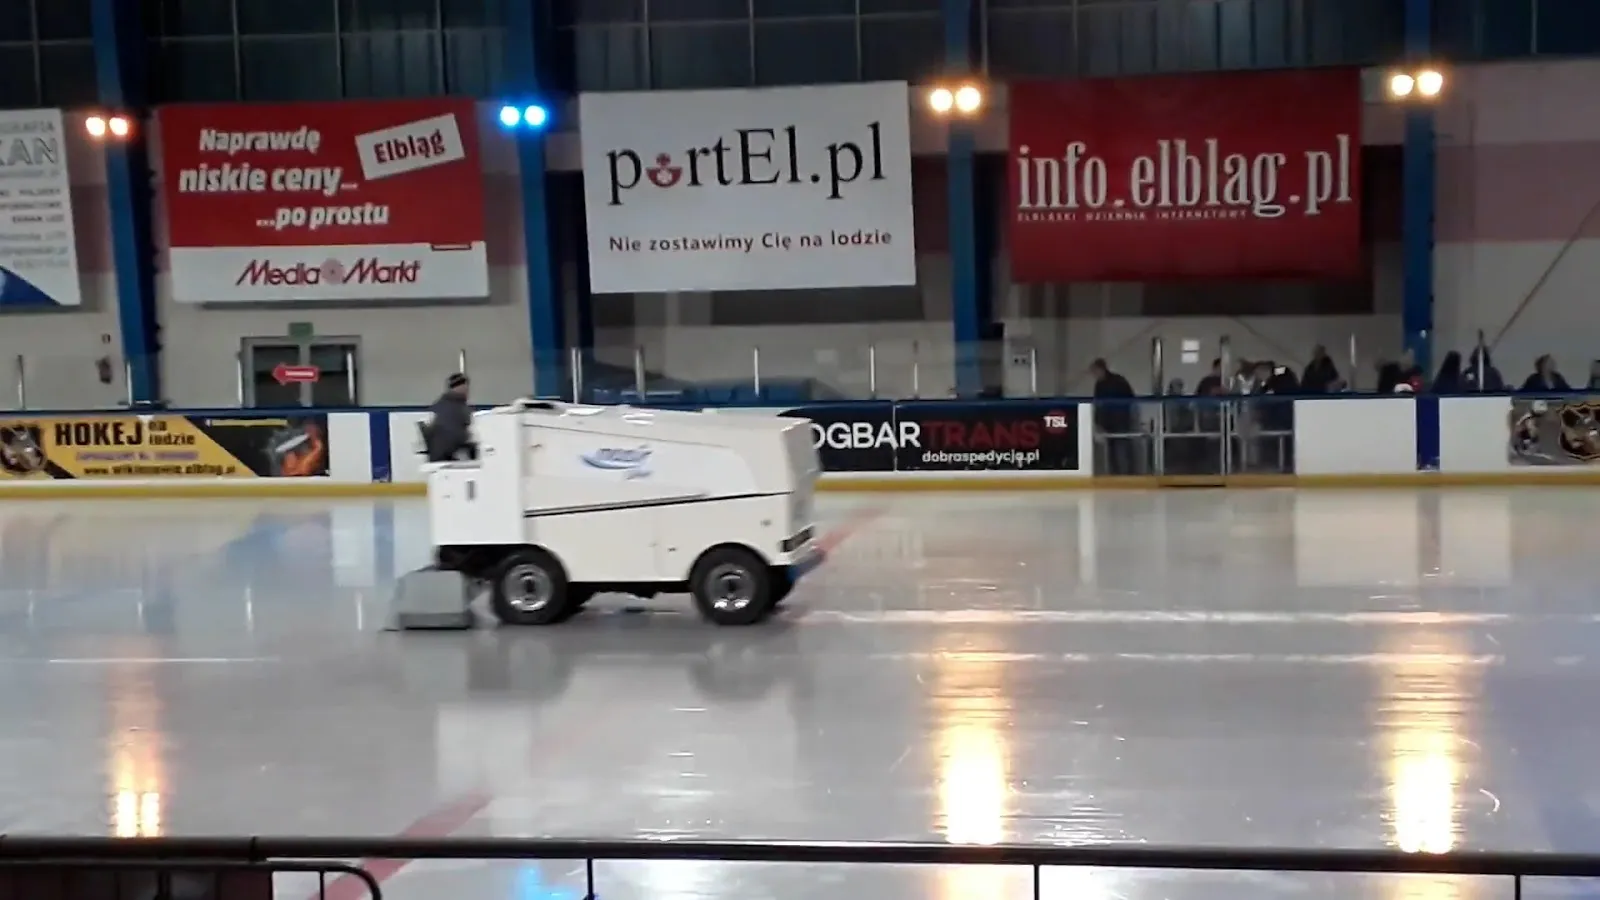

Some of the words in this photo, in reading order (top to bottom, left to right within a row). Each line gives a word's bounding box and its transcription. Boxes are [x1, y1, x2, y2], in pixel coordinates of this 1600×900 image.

[0, 137, 58, 166] AN
[200, 125, 320, 156] Naprawdę
[373, 128, 446, 164] Elbląg
[179, 163, 267, 193] niskie
[1017, 134, 1353, 218] info.elblag.pl
[309, 202, 389, 230] prostu
[608, 236, 641, 252] Nie
[649, 233, 754, 252] zostawimy
[762, 232, 792, 250] Cię
[800, 234, 822, 248] na
[831, 229, 892, 246] lodzie
[236, 259, 320, 286] Media
[342, 258, 420, 283] Markt
[55, 422, 142, 446] HOKEJ
[1044, 415, 1067, 428] TSL
